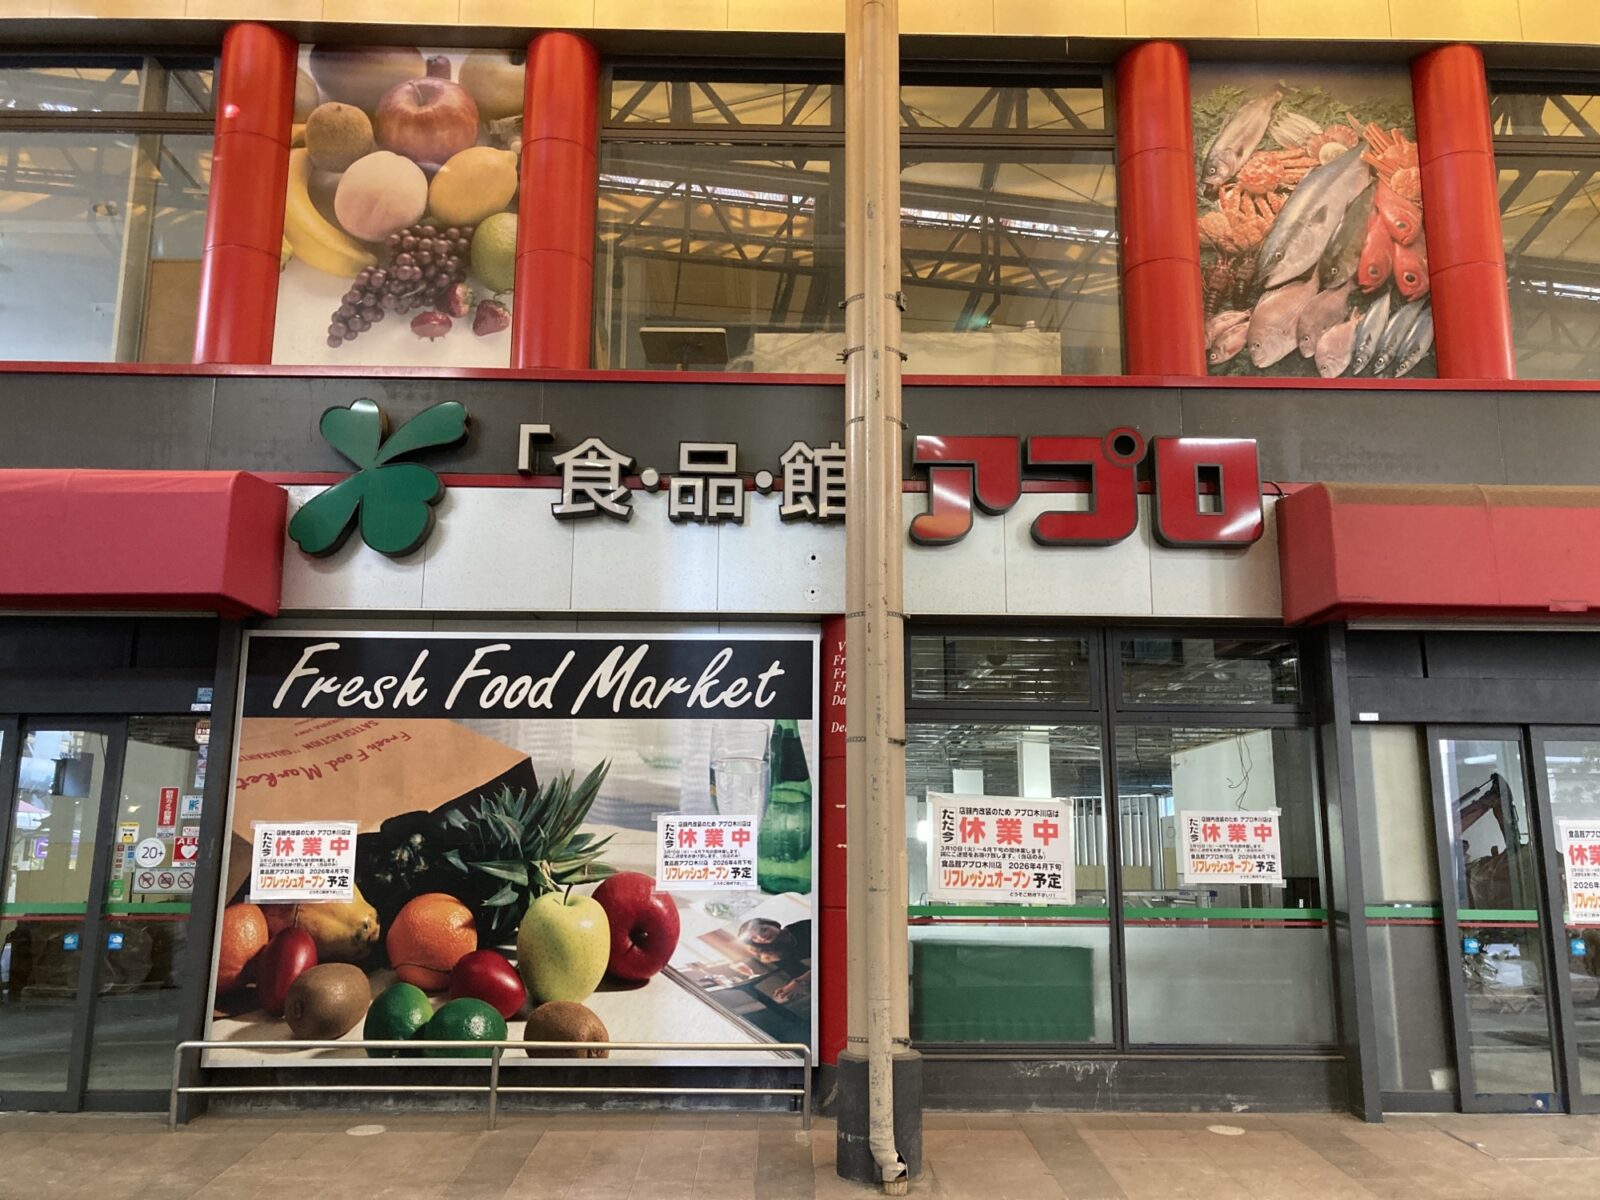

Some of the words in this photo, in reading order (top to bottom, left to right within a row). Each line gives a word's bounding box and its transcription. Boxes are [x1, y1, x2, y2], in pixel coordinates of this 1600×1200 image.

[909, 427, 1264, 546] アプロ
[272, 642, 429, 710] Fresh
[445, 643, 576, 709] Food
[571, 643, 786, 715] Market
[302, 720, 379, 750] SATISFACTION
[367, 731, 412, 752] Fresh
[324, 749, 370, 772] Food
[236, 764, 323, 790] Market
[1014, 809, 1059, 817] アプロ木川店は
[665, 823, 675, 848] ただ今
[942, 809, 955, 843] ただ今
[959, 817, 1058, 846] 休業中
[1189, 818, 1199, 842] ただ今
[1202, 824, 1272, 842] 休業中
[262, 832, 273, 857] ただ今
[275, 837, 349, 856] 休業中
[678, 828, 750, 848] 休業中
[141, 846, 163, 860] 20+
[665, 867, 729, 879] リフレッシュオープン
[731, 867, 752, 879] 予定
[941, 860, 1002, 869] 食品館アプロ木川店
[1008, 862, 1062, 871] 2026年4月下旬
[1192, 860, 1254, 872] リフレッシュオープン
[1256, 861, 1276, 873] 予定
[260, 875, 326, 888] リフレッシュオープン
[327, 876, 349, 888] 予定
[943, 870, 1031, 889] リフレッシュオープン
[1033, 872, 1062, 889] 予定
